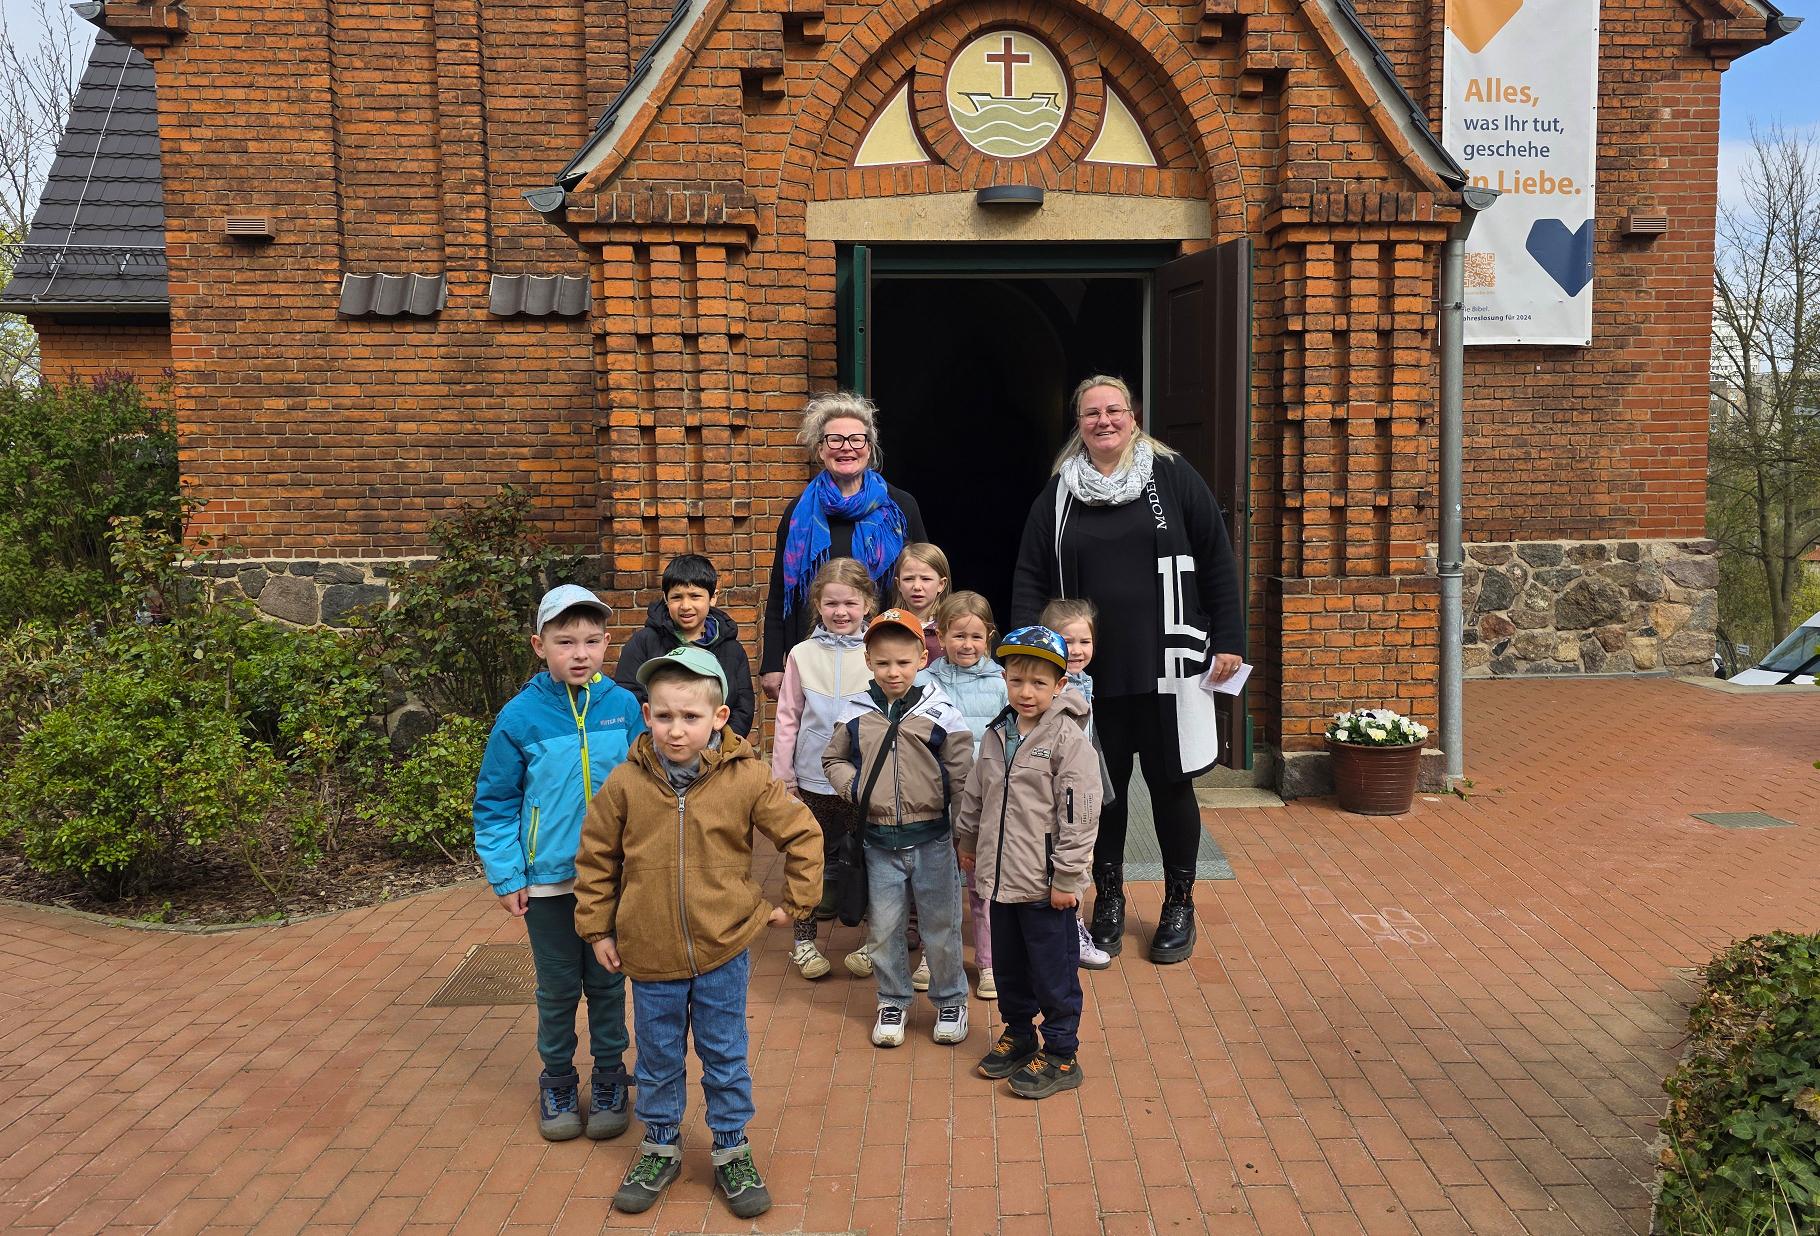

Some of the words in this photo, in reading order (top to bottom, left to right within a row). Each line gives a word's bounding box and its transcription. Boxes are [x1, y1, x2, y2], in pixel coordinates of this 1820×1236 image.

[1464, 77, 1539, 107] Alles,
[1464, 118, 1499, 131] was
[1504, 114, 1528, 132] Ihr
[1532, 117, 1564, 135] tut,
[1463, 140, 1550, 161] geschehe
[1498, 170, 1581, 194] Liebe.
